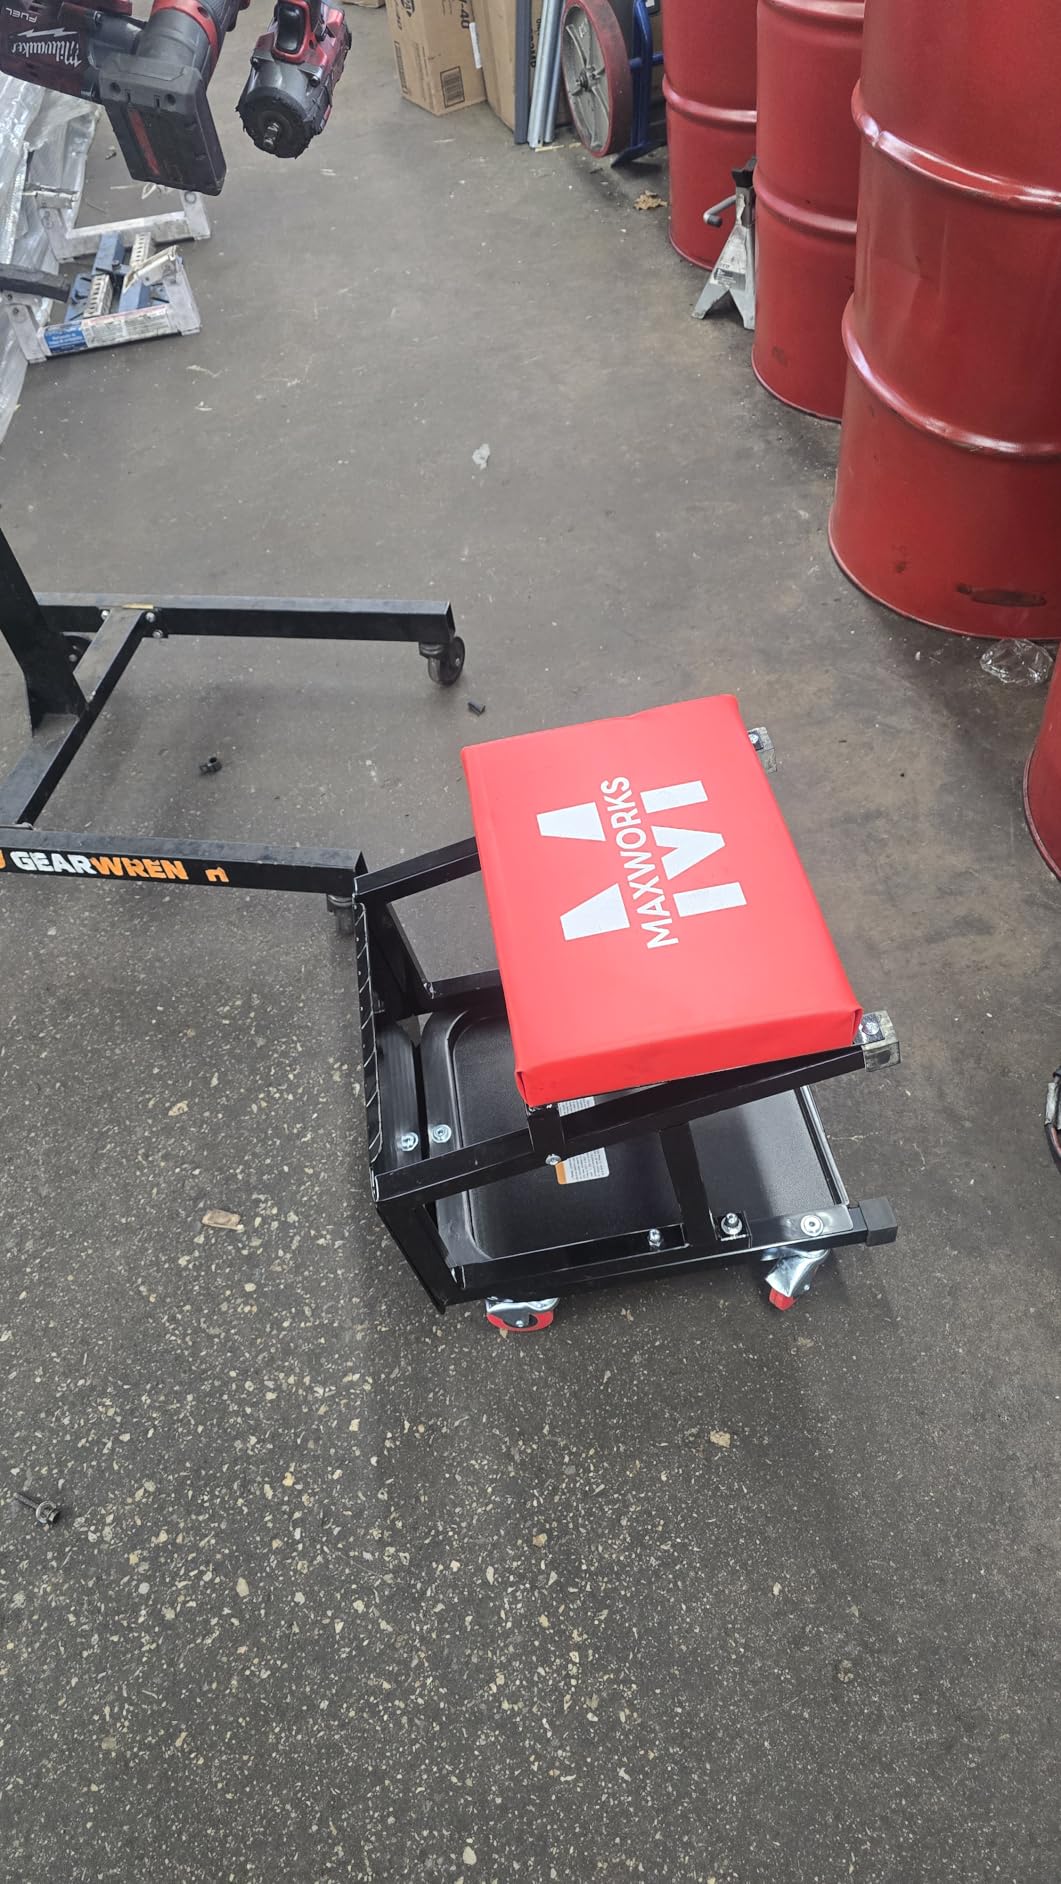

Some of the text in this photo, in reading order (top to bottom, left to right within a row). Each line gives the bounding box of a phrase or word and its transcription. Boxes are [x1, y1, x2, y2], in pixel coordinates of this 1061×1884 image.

[5, 7, 38, 23] FUEL
[9, 850, 230, 883] GEARWREN
[600, 776, 679, 949] MAXWORKS
